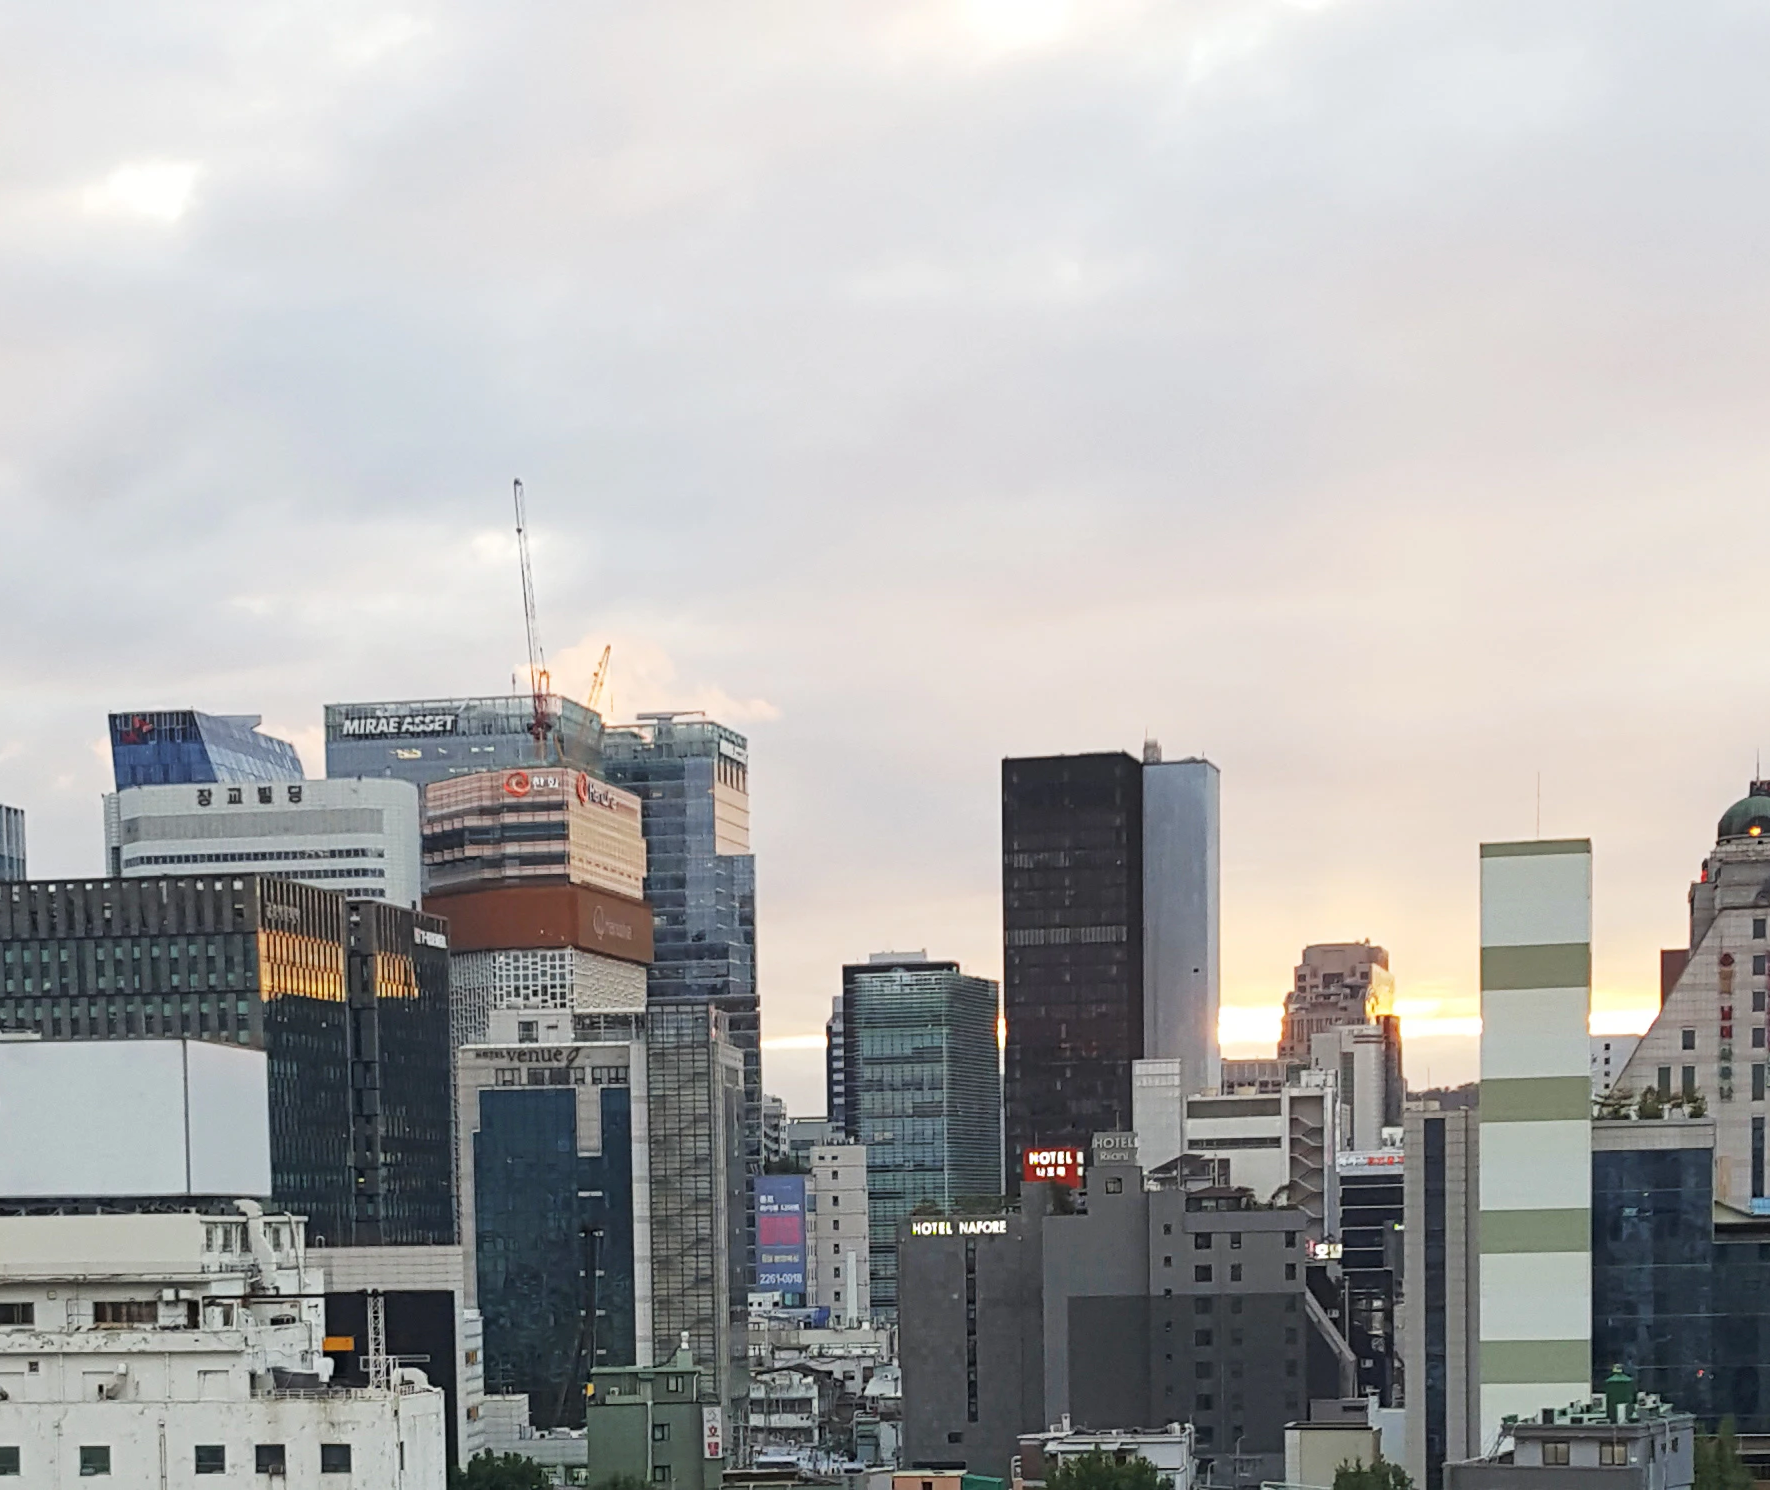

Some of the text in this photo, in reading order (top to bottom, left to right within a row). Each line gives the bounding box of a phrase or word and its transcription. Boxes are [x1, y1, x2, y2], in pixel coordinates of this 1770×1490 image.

[343, 715, 455, 735] MIRAE ASSET
[533, 776, 558, 790] 한화
[197, 784, 302, 806] 장교빌딩
[506, 1048, 563, 1063] venue
[1094, 1138, 1134, 1148] HOTEL
[1029, 1151, 1073, 1165] HOTEL
[912, 1220, 1006, 1235] HOTEL NAFORE
